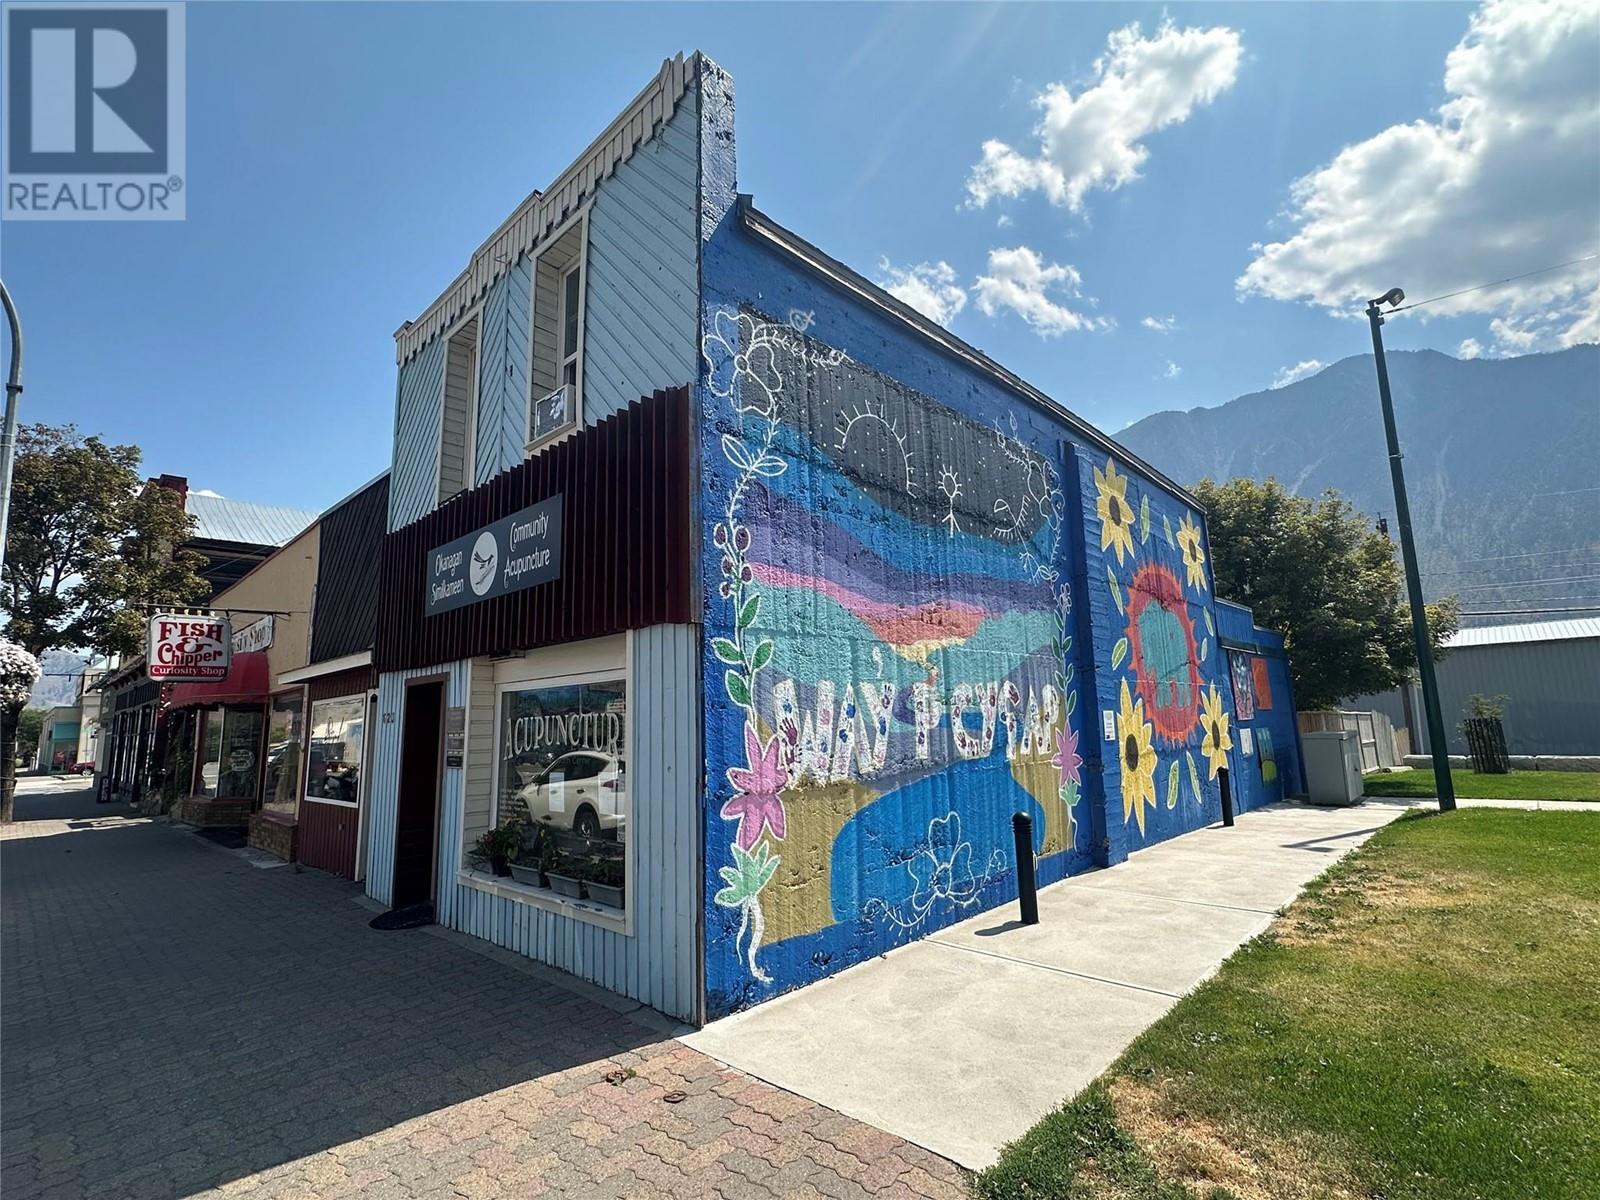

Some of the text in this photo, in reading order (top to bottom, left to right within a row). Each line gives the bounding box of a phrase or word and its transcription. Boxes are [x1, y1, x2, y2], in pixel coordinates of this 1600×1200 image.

[509, 511, 549, 552] Community
[435, 551, 463, 577] Okanagan
[504, 547, 550, 589] Acupuncture
[430, 578, 464, 606] Similkameen
[157, 622, 225, 643] FISH
[157, 643, 223, 666] Chipper
[175, 637, 212, 653] &
[152, 666, 225, 677] Curiosity Shop
